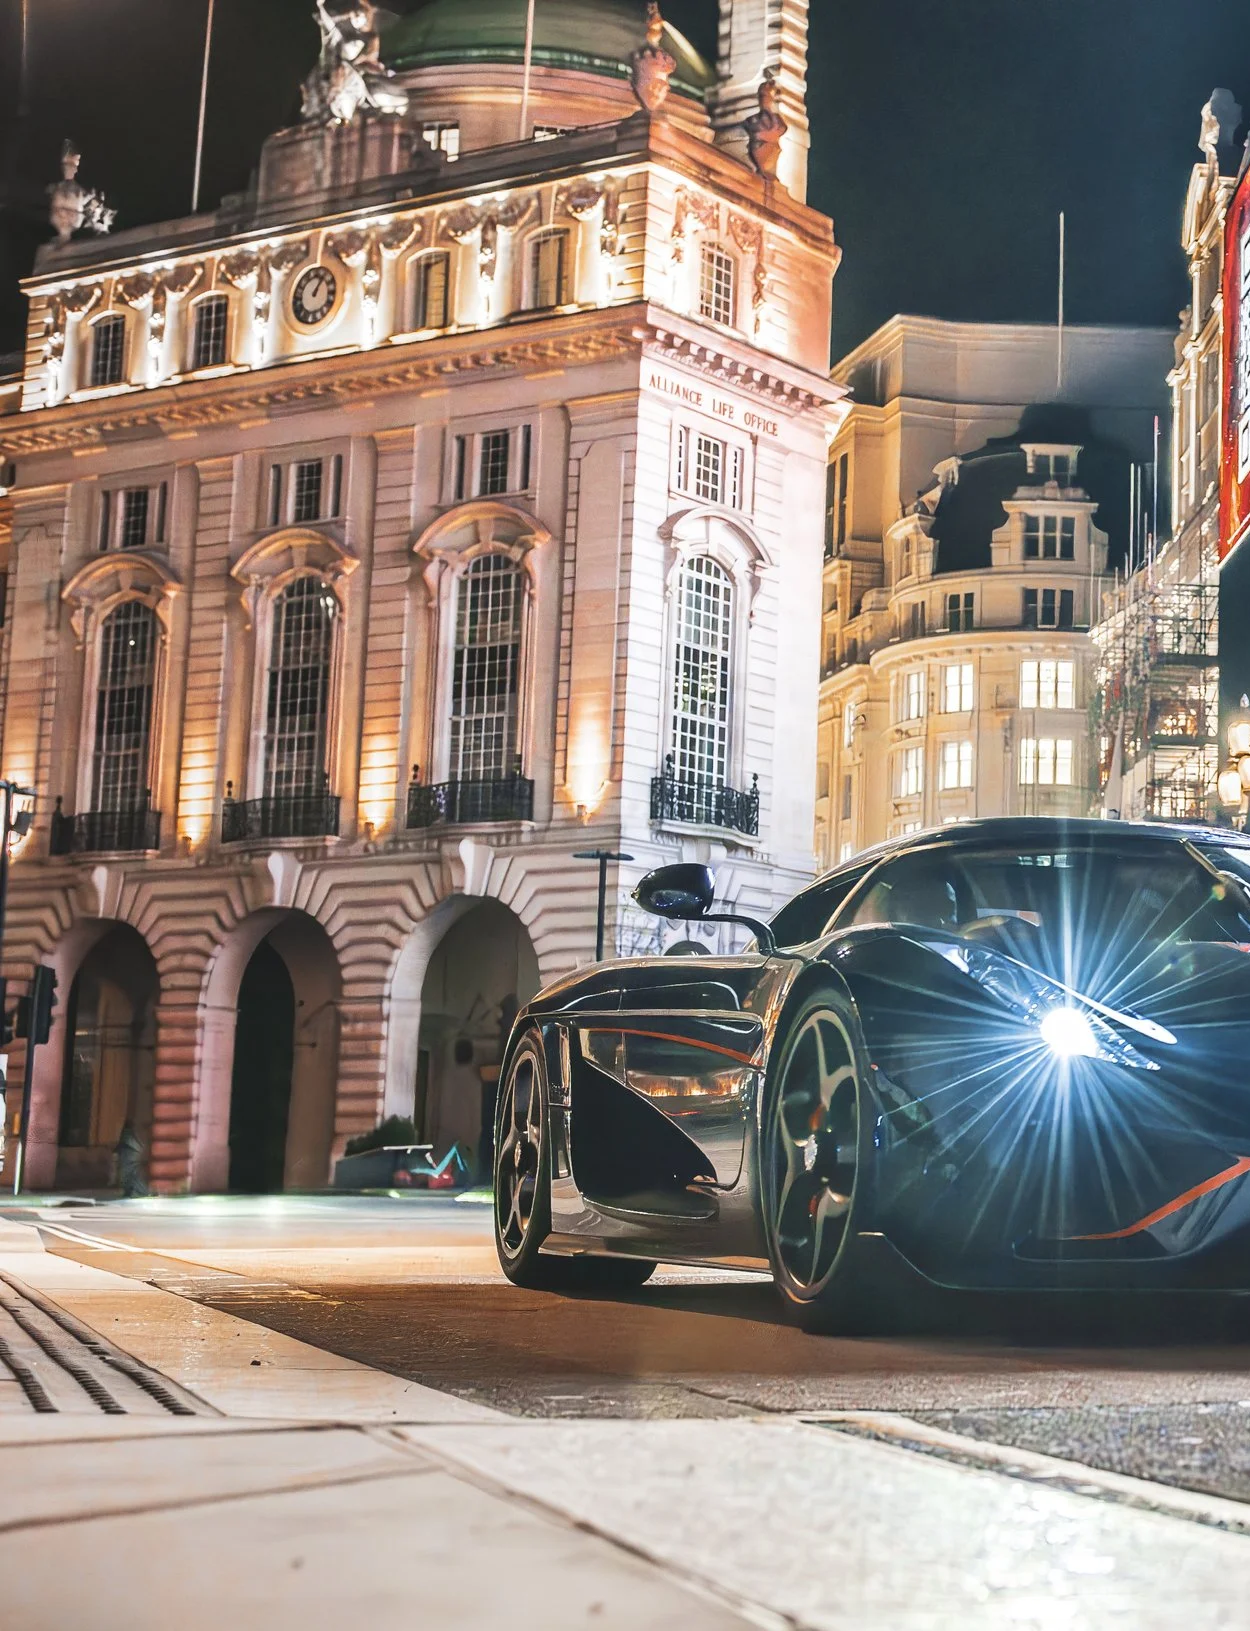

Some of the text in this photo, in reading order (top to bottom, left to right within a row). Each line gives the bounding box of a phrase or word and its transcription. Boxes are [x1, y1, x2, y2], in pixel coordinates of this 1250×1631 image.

[649, 374, 779, 437] ALLIANCE LIFE OFFICE
